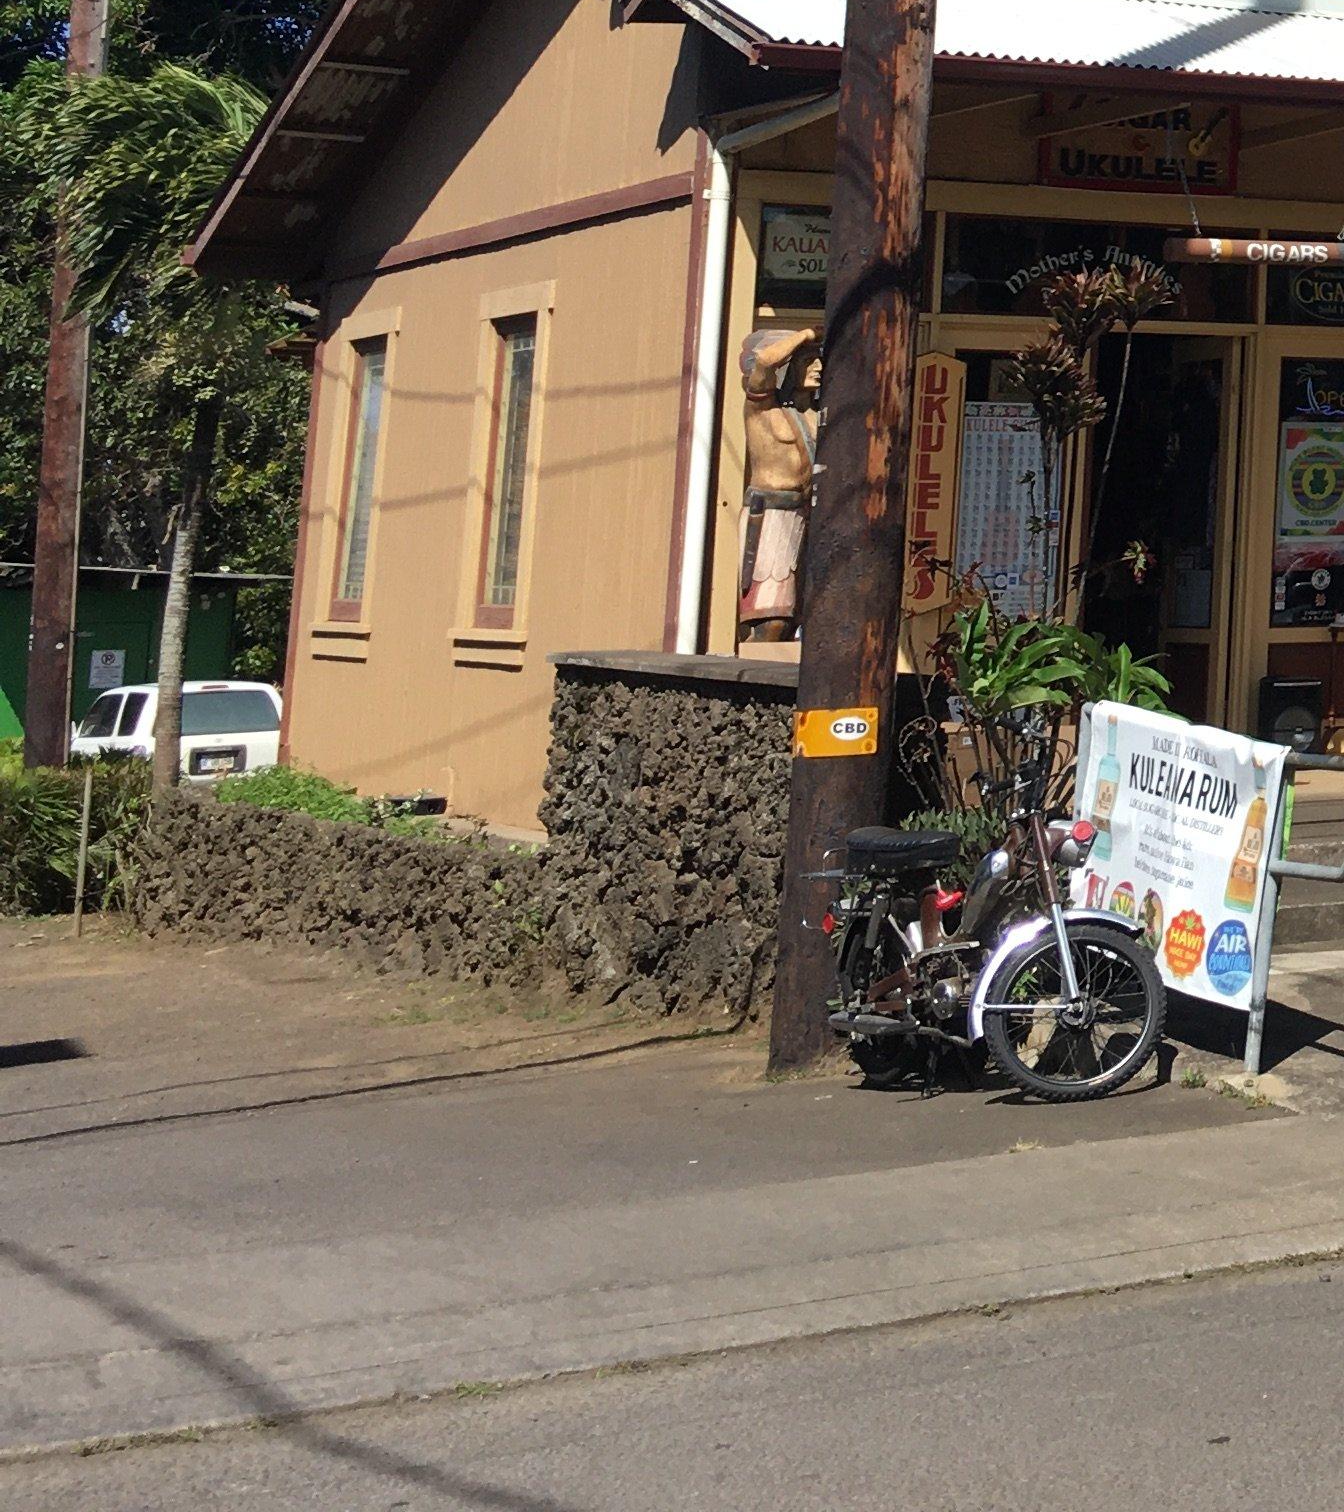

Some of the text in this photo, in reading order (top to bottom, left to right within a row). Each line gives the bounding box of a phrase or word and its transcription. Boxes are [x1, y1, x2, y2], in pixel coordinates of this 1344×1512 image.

[1060, 147, 1217, 184] UKULELE
[772, 235, 831, 254] KAUA
[1247, 242, 1328, 262] CIGARS
[797, 258, 828, 274] SOL
[1005, 245, 1095, 294] Mother's
[910, 363, 949, 601] UKULELES
[833, 722, 867, 734] CBD
[1129, 752, 1238, 820] KULEANA RUM
[1214, 933, 1247, 953] AIR
